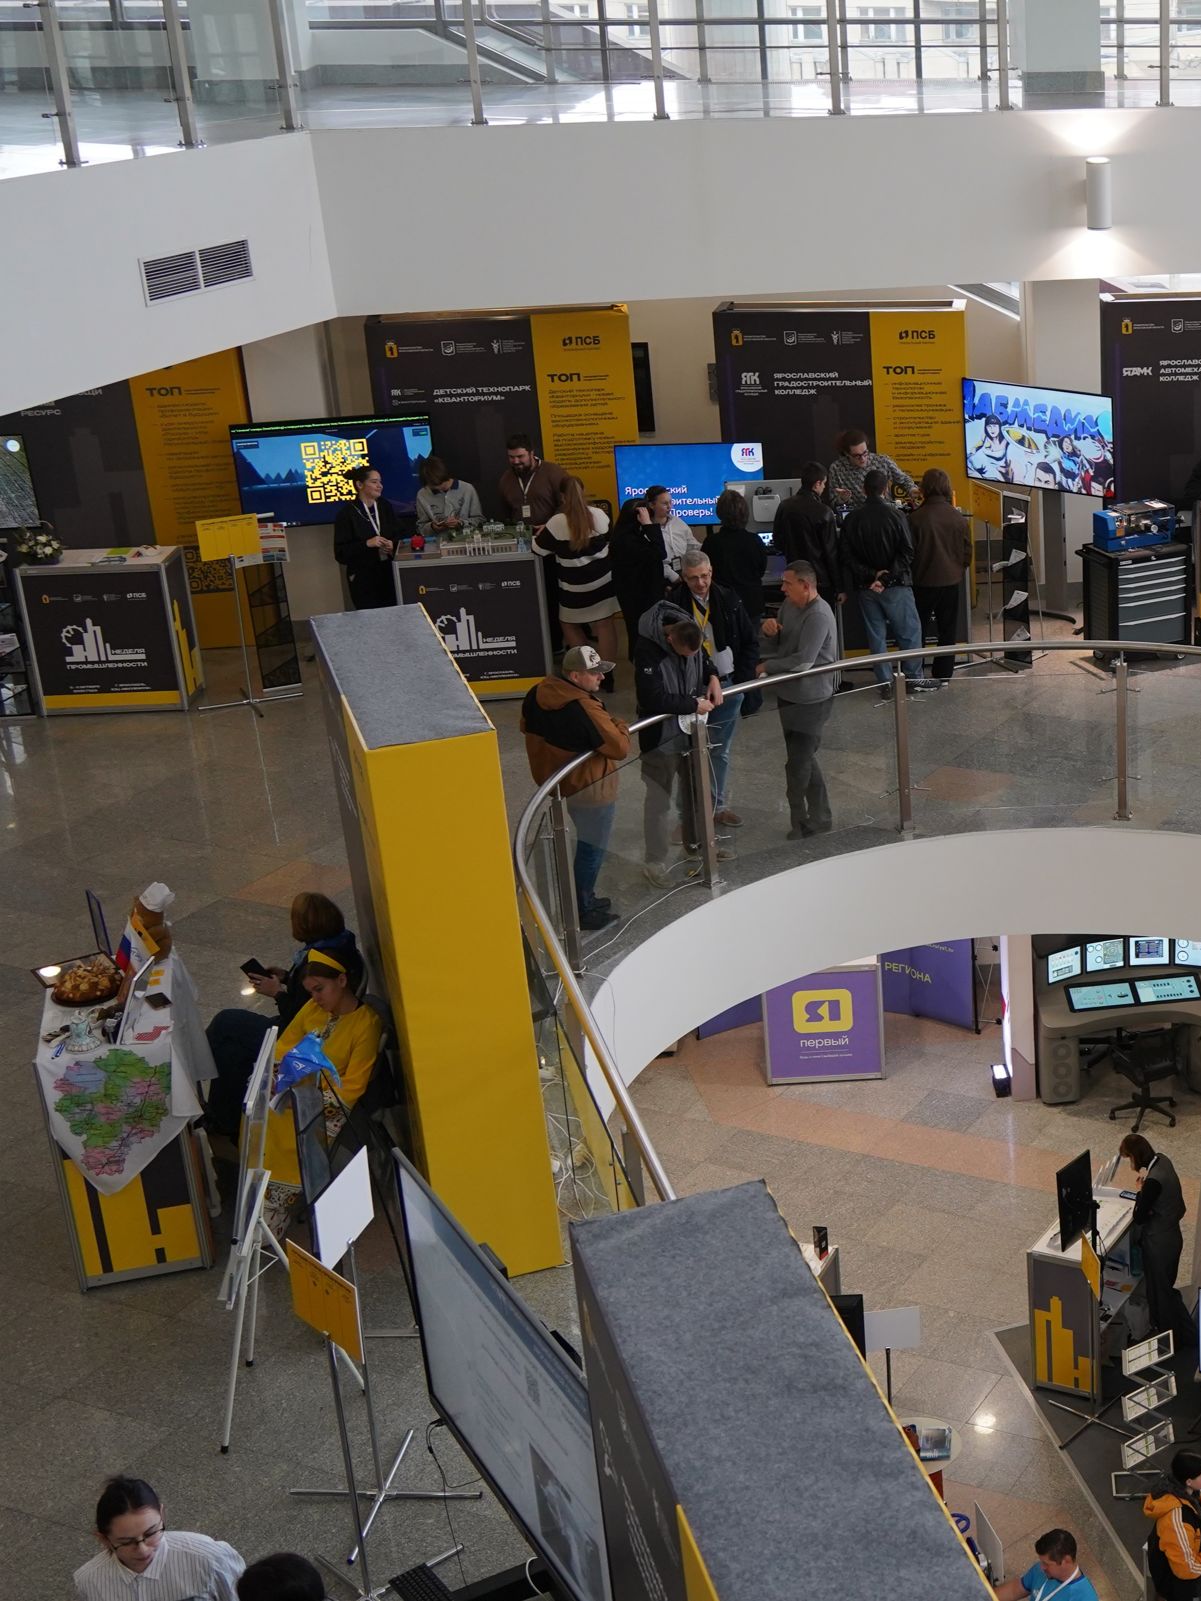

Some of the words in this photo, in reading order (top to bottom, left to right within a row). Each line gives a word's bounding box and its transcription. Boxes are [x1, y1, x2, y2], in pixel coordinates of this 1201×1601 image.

[911, 329, 936, 340] ПСБ
[575, 335, 600, 347] ПСБ
[883, 365, 915, 375] ТОП
[547, 372, 581, 383] ТОП
[774, 379, 872, 387] ГРАДОСТРОИТЕЛЬНЫЙ
[146, 386, 182, 397] ТОП
[433, 387, 476, 396] ДЕТСКИЙ
[477, 385, 531, 394] ТЕХНОПАРК
[434, 395, 505, 403] «КВАНТОРИУМ»
[21, 409, 62, 417] РЕСУРС
[452, 649, 518, 658] МЫШЛЕННОСТИ
[66, 662, 148, 670] ПРОМЫШЛЕННОСТИ
[885, 961, 933, 984] РЕГИОНА
[800, 1034, 849, 1049] первый
